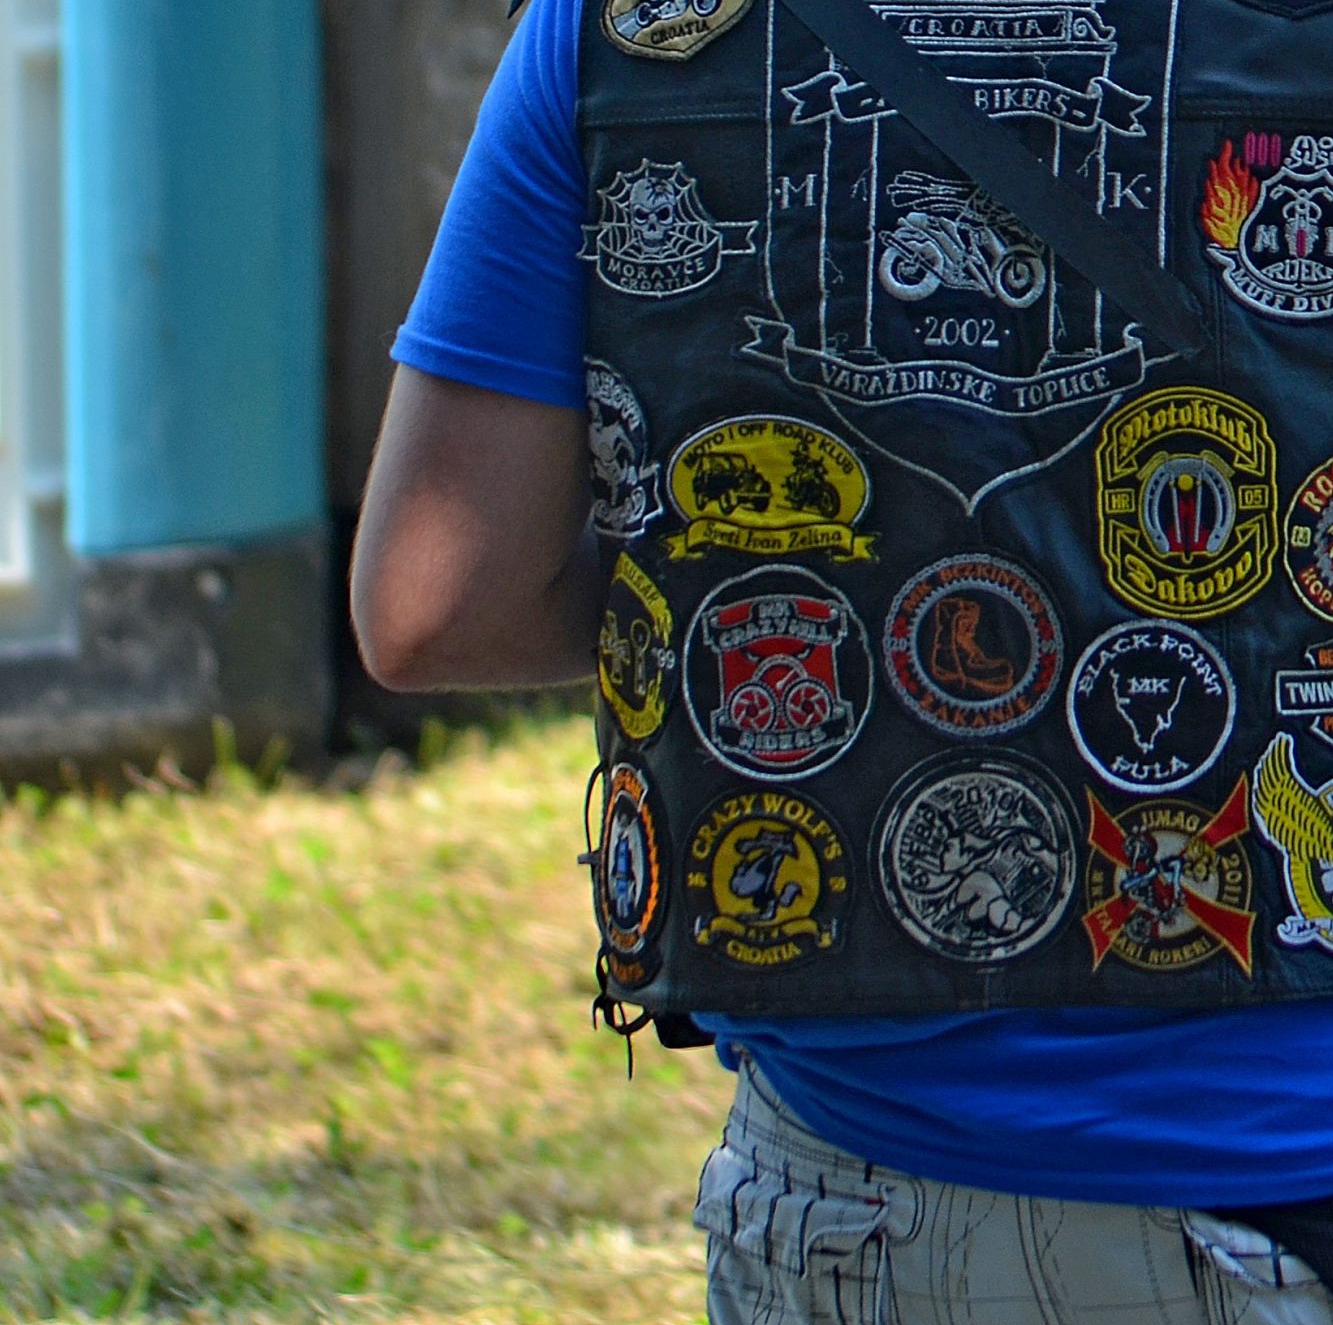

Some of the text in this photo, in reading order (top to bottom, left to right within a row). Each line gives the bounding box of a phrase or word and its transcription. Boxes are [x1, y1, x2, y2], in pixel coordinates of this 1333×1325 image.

[651, 20, 711, 45] CROATIA
[908, 17, 1045, 37] CROATIA
[974, 87, 1070, 118] BIKERS
[781, 172, 1148, 209] M K
[1253, 224, 1280, 253] M
[619, 276, 694, 291] CROATIA
[1265, 260, 1333, 281] RIJEKA
[1232, 270, 1286, 310] MUFF
[924, 315, 999, 347] 2002
[820, 361, 1111, 409] VARAŽDINSKE TOPLICE
[683, 432, 725, 469] MOTO
[738, 423, 768, 437] OFF
[773, 423, 816, 444] ROAD
[818, 438, 854, 475] KLUB
[1111, 493, 1131, 509] HR
[788, 528, 843, 549] Zelina
[1077, 634, 1223, 697] BLACK POINT
[1127, 677, 1170, 695] MK
[739, 726, 827, 750] RIDERS
[1111, 755, 1190, 780] PULA
[692, 793, 758, 861] CRAZY
[727, 939, 801, 966] CROATIA
